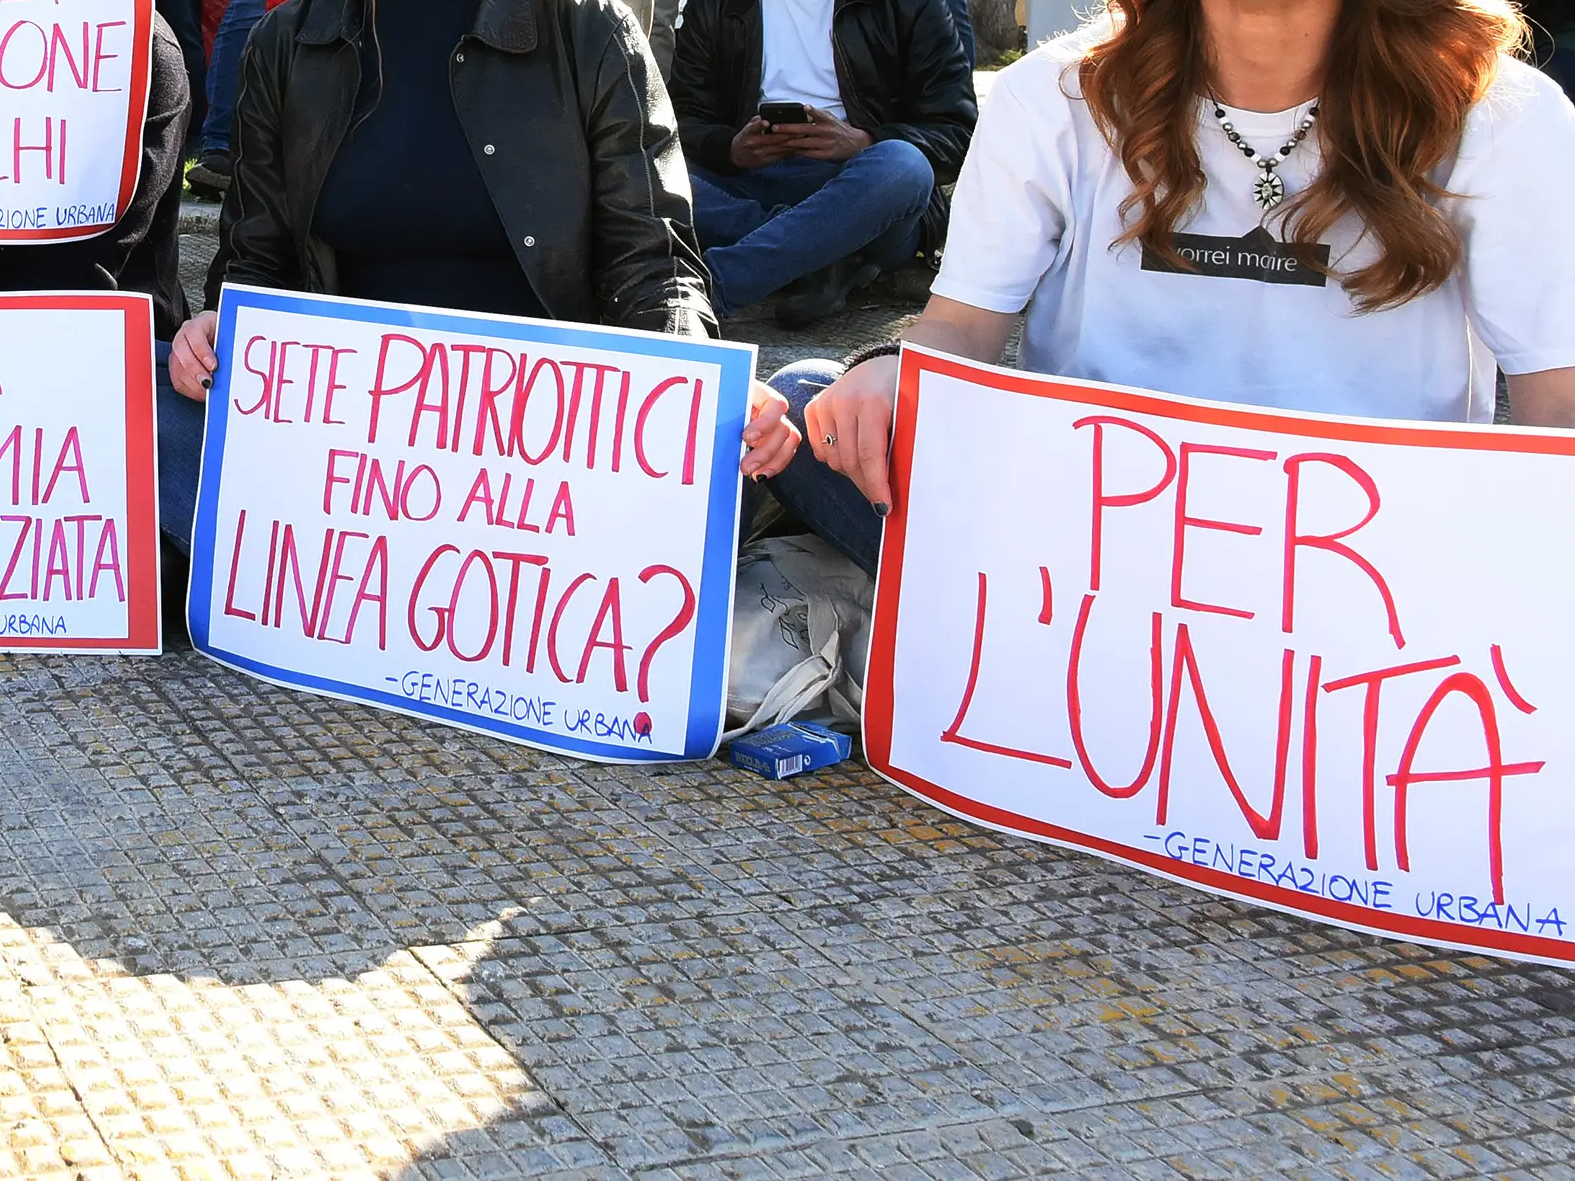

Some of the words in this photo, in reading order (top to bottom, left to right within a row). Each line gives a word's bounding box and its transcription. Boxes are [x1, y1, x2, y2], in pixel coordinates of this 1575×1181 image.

[56, 202, 117, 228] URBANA
[234, 334, 359, 426] SIETE
[367, 333, 704, 486] PATRIOTTICI
[322, 448, 442, 522] FINO
[456, 466, 577, 537] ALLA
[1073, 414, 1406, 649] PER
[223, 508, 389, 652] LINEA
[408, 542, 698, 738] GOTICA?
[564, 706, 654, 746] URBANA
[940, 566, 1546, 906] L'UNITÀ
[1415, 886, 1568, 935] URBANA
